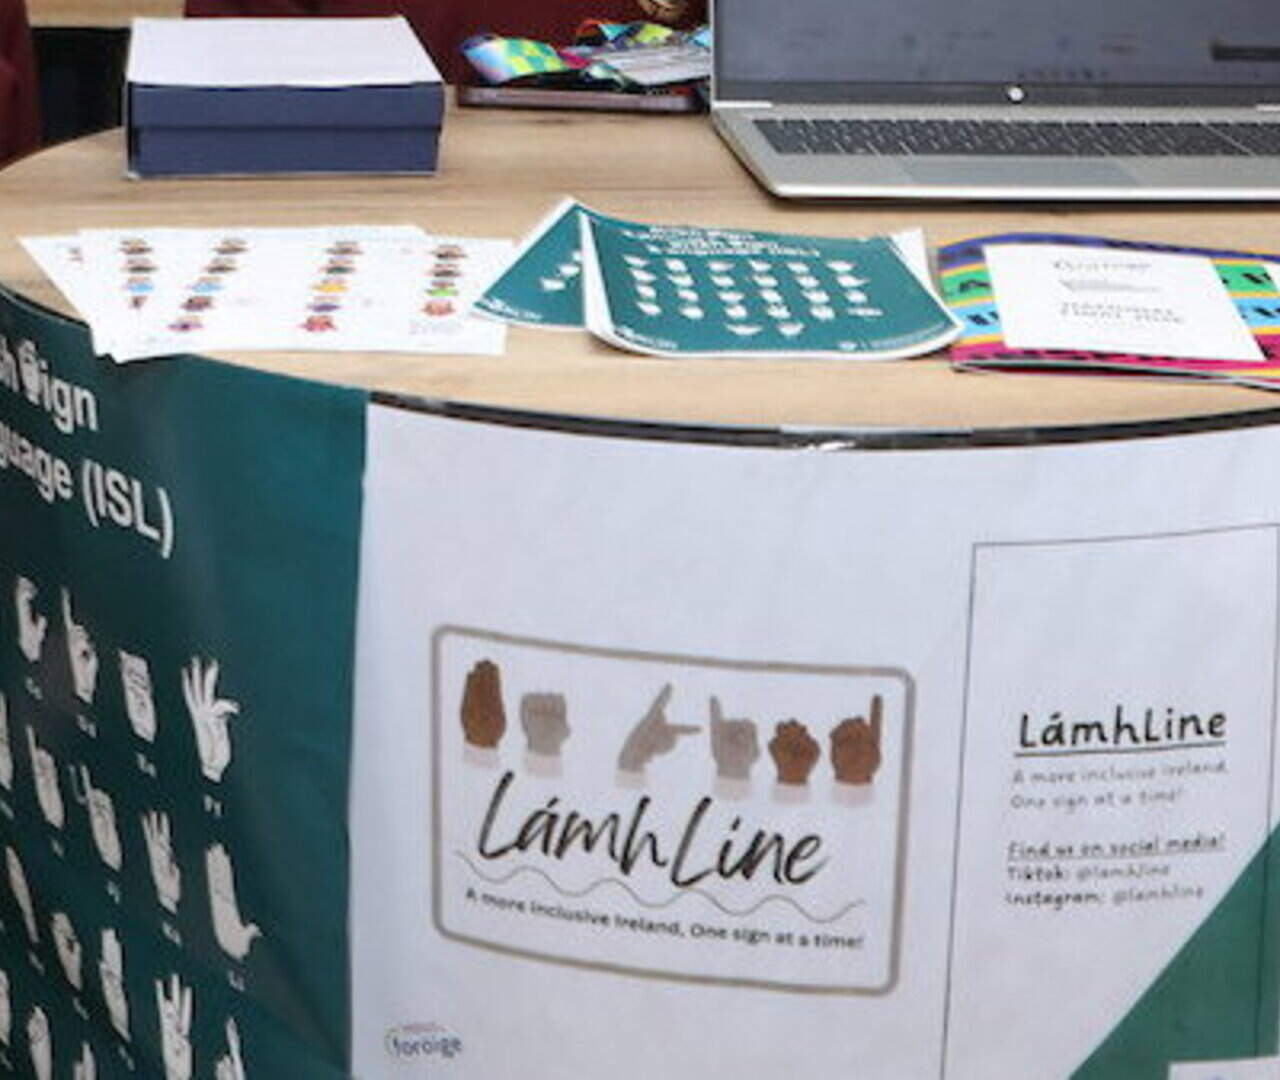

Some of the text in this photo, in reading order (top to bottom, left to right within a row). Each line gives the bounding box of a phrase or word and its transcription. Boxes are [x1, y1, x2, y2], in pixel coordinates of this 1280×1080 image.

[82, 458, 175, 561] (ISL)
[1030, 770, 1076, 784] more
[1010, 793, 1046, 810] One
[1053, 796, 1089, 814] sign
[1094, 791, 1114, 807] at
[1008, 841, 1050, 859] Find
[1080, 843, 1104, 856] on
[1110, 836, 1160, 856] social
[466, 887, 478, 901] A
[482, 894, 526, 914] more
[531, 901, 610, 927] inclusive
[690, 924, 728, 940] One
[733, 926, 771, 947] sign
[776, 932, 794, 946] at
[798, 936, 810, 947] a
[814, 931, 863, 950] time!
